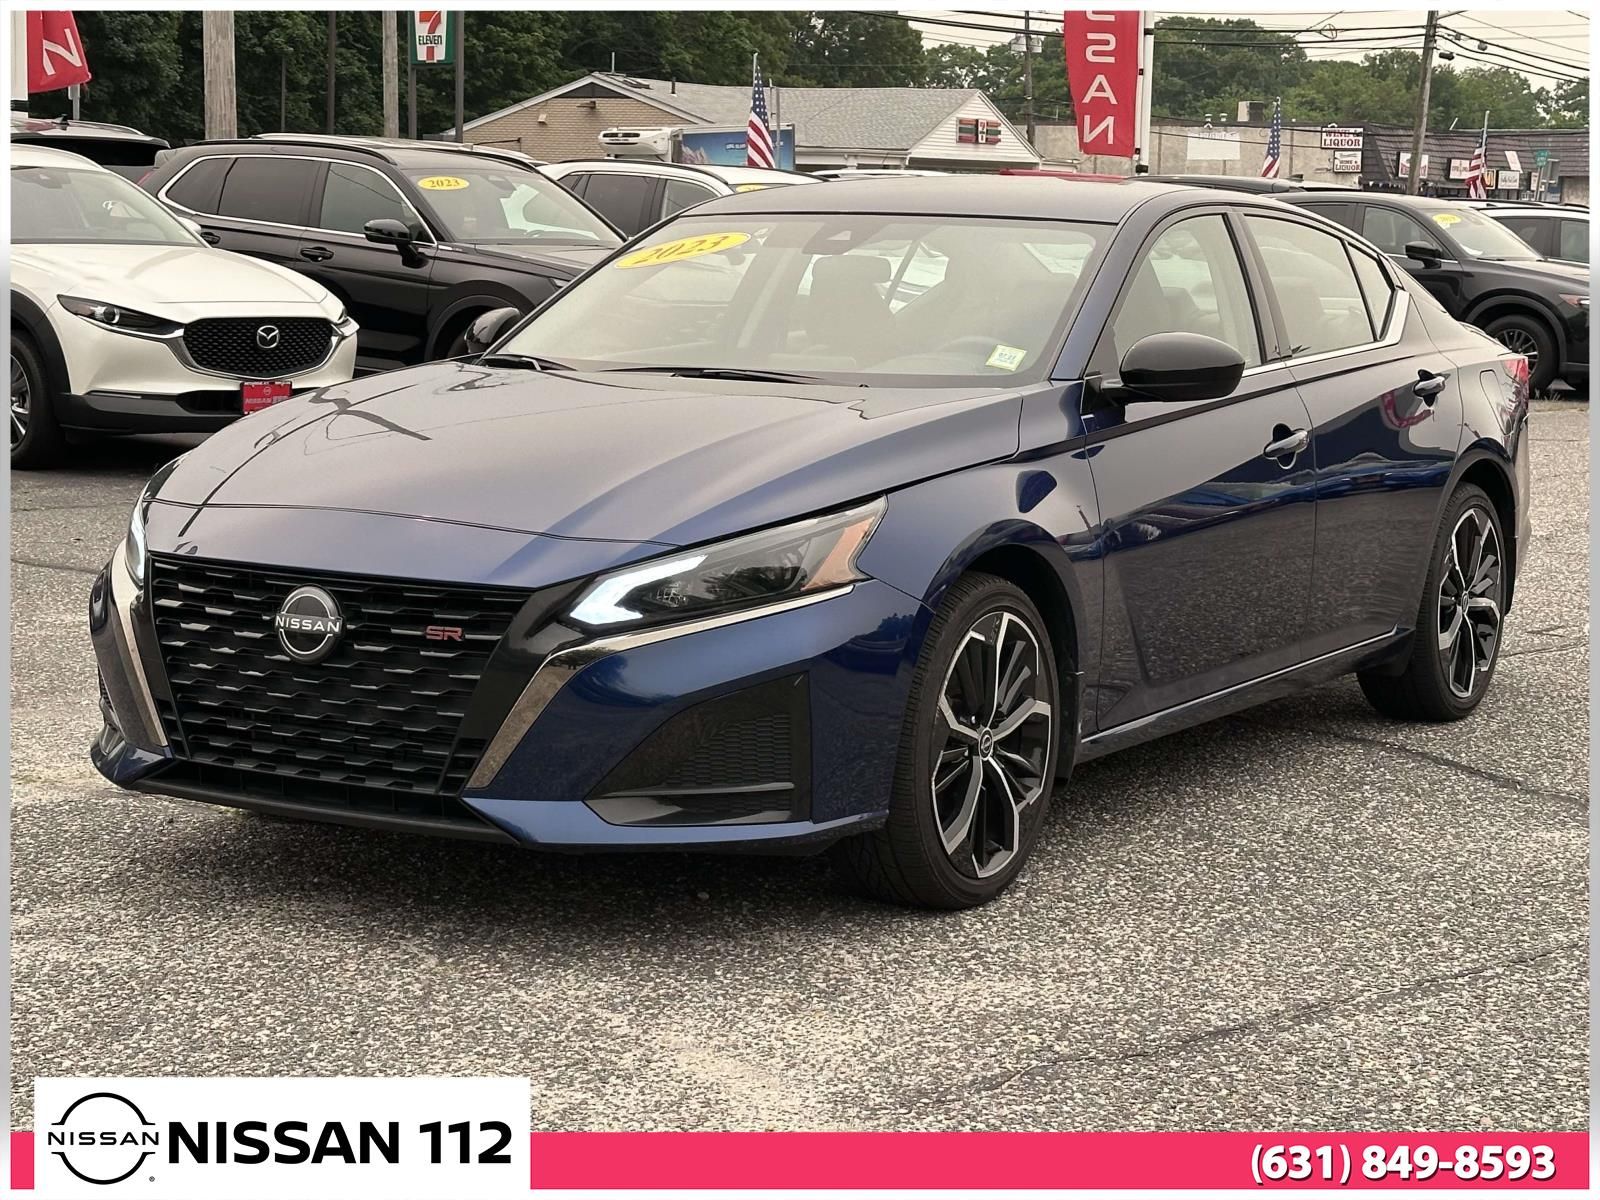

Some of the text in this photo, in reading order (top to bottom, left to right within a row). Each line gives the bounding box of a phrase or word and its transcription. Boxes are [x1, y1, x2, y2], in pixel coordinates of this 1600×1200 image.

[1323, 138, 1361, 147] LIQUOR
[427, 179, 460, 188] 2023
[630, 235, 730, 265] 2023
[275, 616, 340, 633] NISSAN
[425, 625, 463, 641] SR
